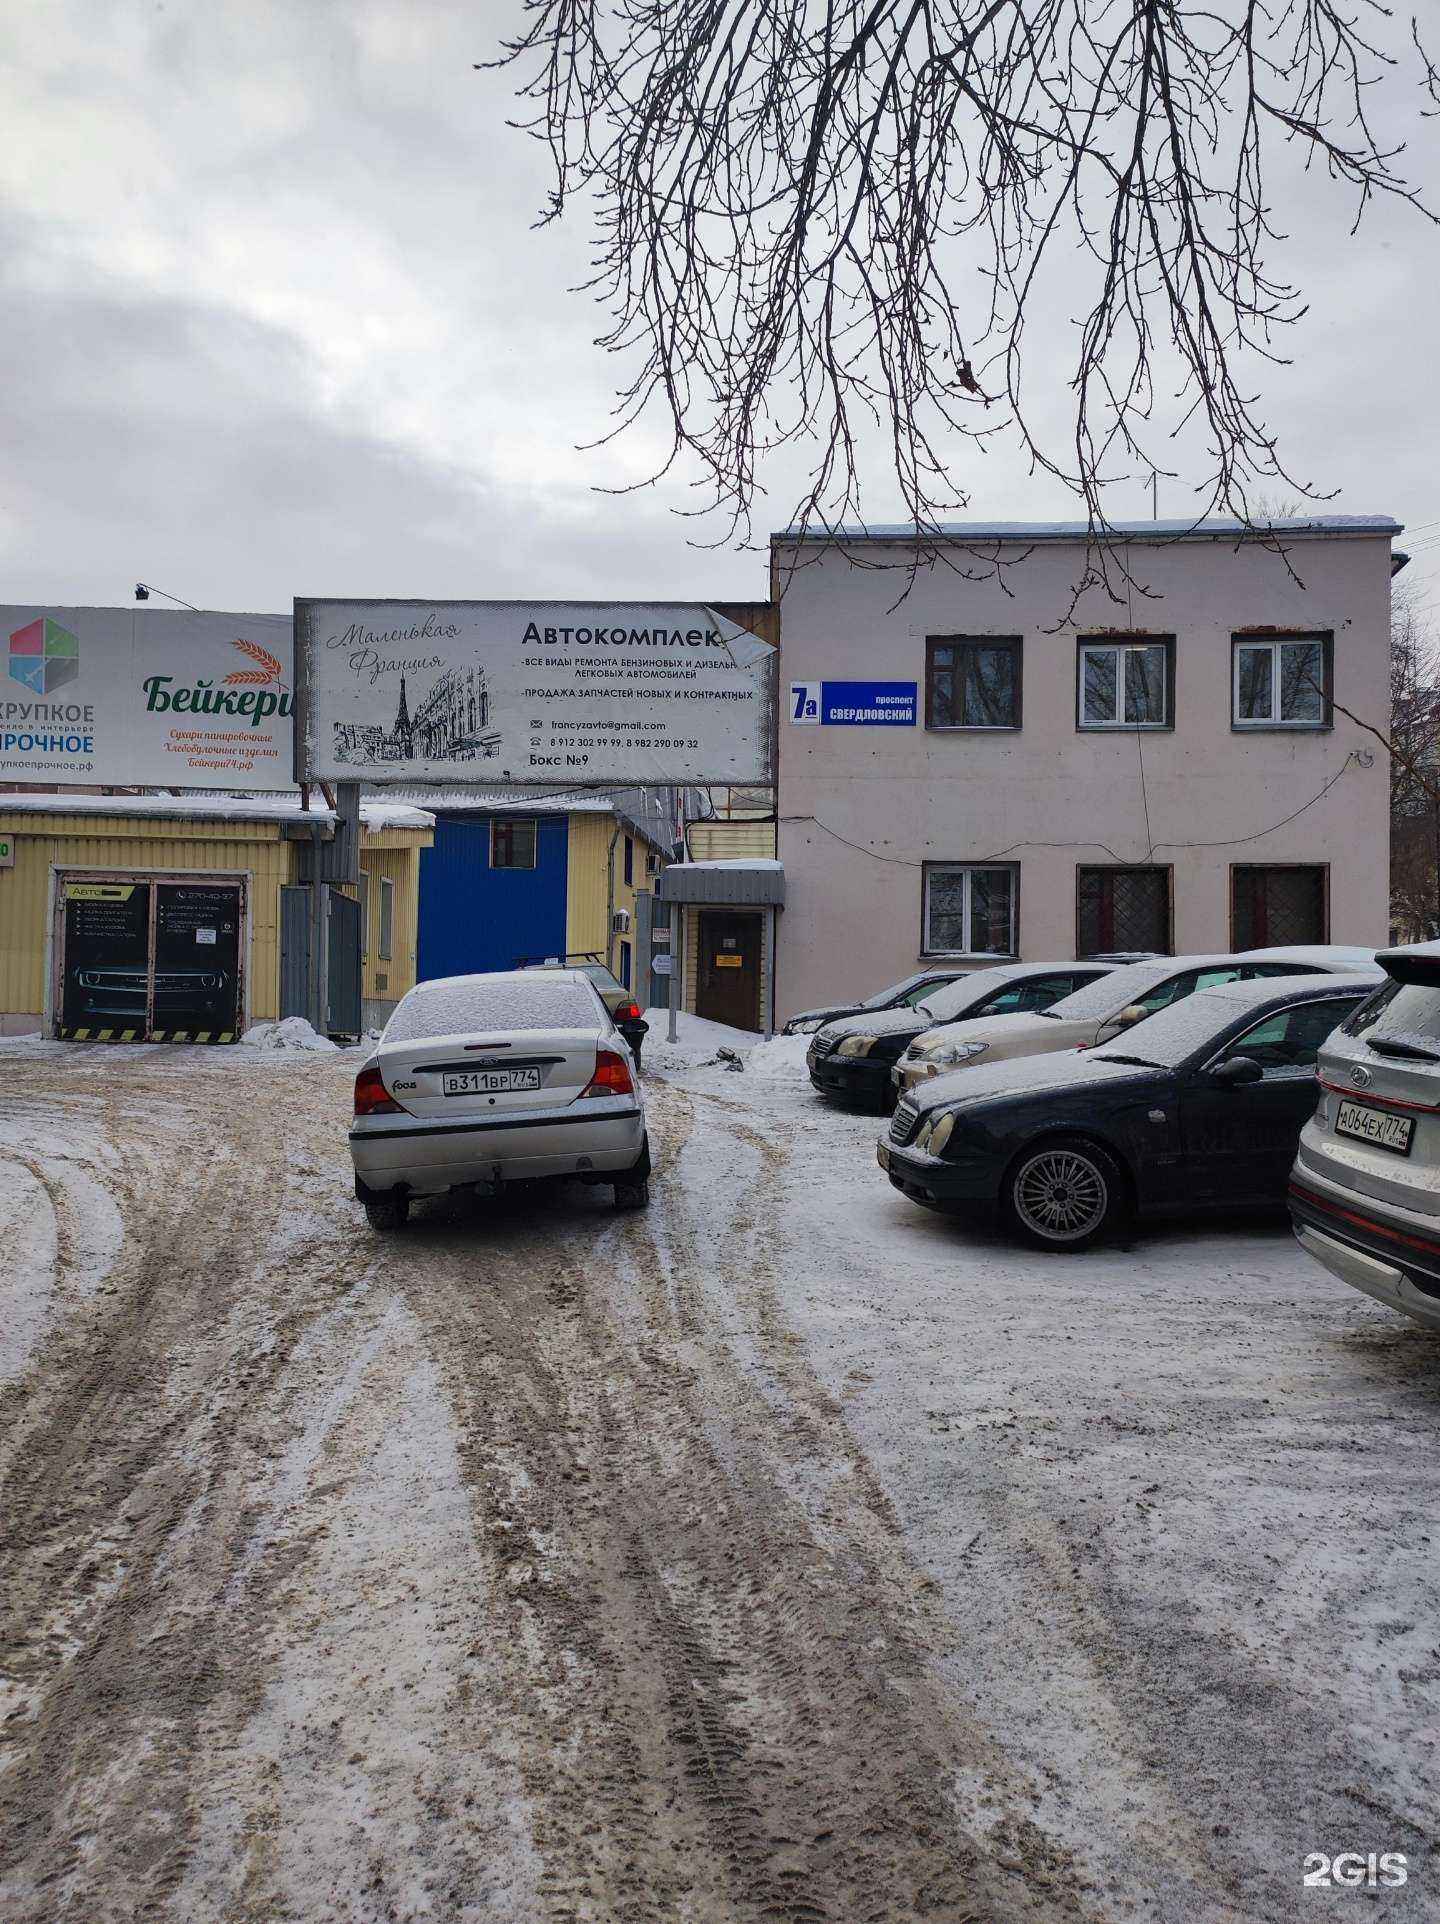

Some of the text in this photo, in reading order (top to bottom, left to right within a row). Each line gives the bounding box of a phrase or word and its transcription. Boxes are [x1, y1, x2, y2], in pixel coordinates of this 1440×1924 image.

[326, 613, 462, 649] Маленькая
[521, 622, 722, 647] Автокомплек
[350, 649, 446, 685] Франция
[545, 658, 572, 667] ВИДЫ
[574, 658, 618, 667] РЕМОНТА
[621, 659, 683, 668] БЕНЗИНОВЫХ
[685, 659, 693, 667] И
[694, 660, 751, 670] ДИЗЕЛЬН
[574, 669, 697, 679] ЛЕГКОВЫХ АВТОМОБИЛЕЙ
[578, 688, 634, 698] ЗАПЧАСТЕЙ
[636, 690, 672, 698] НОВЫХ
[674, 690, 681, 698] И
[683, 690, 753, 701] КОНТРАКТНЫХ
[875, 696, 914, 705] проспект
[791, 687, 817, 719] 7а
[829, 706, 913, 721] СВЕРДЛОВСКИЙ
[40, 724, 94, 733] интерьере
[169, 729, 203, 741] Сухари
[0, 733, 94, 753] РОЧНОЕ
[550, 738, 556, 747] 8
[558, 738, 575, 747] 912
[577, 738, 594, 747] 302
[597, 738, 608, 747] 99
[626, 739, 632, 747] 8
[635, 739, 651, 748] 982
[654, 739, 671, 748] 290
[673, 740, 685, 748] 09
[687, 740, 699, 748] 32
[163, 742, 279, 759] Хлебобулочные изделия
[529, 755, 589, 766] Бокс №9
